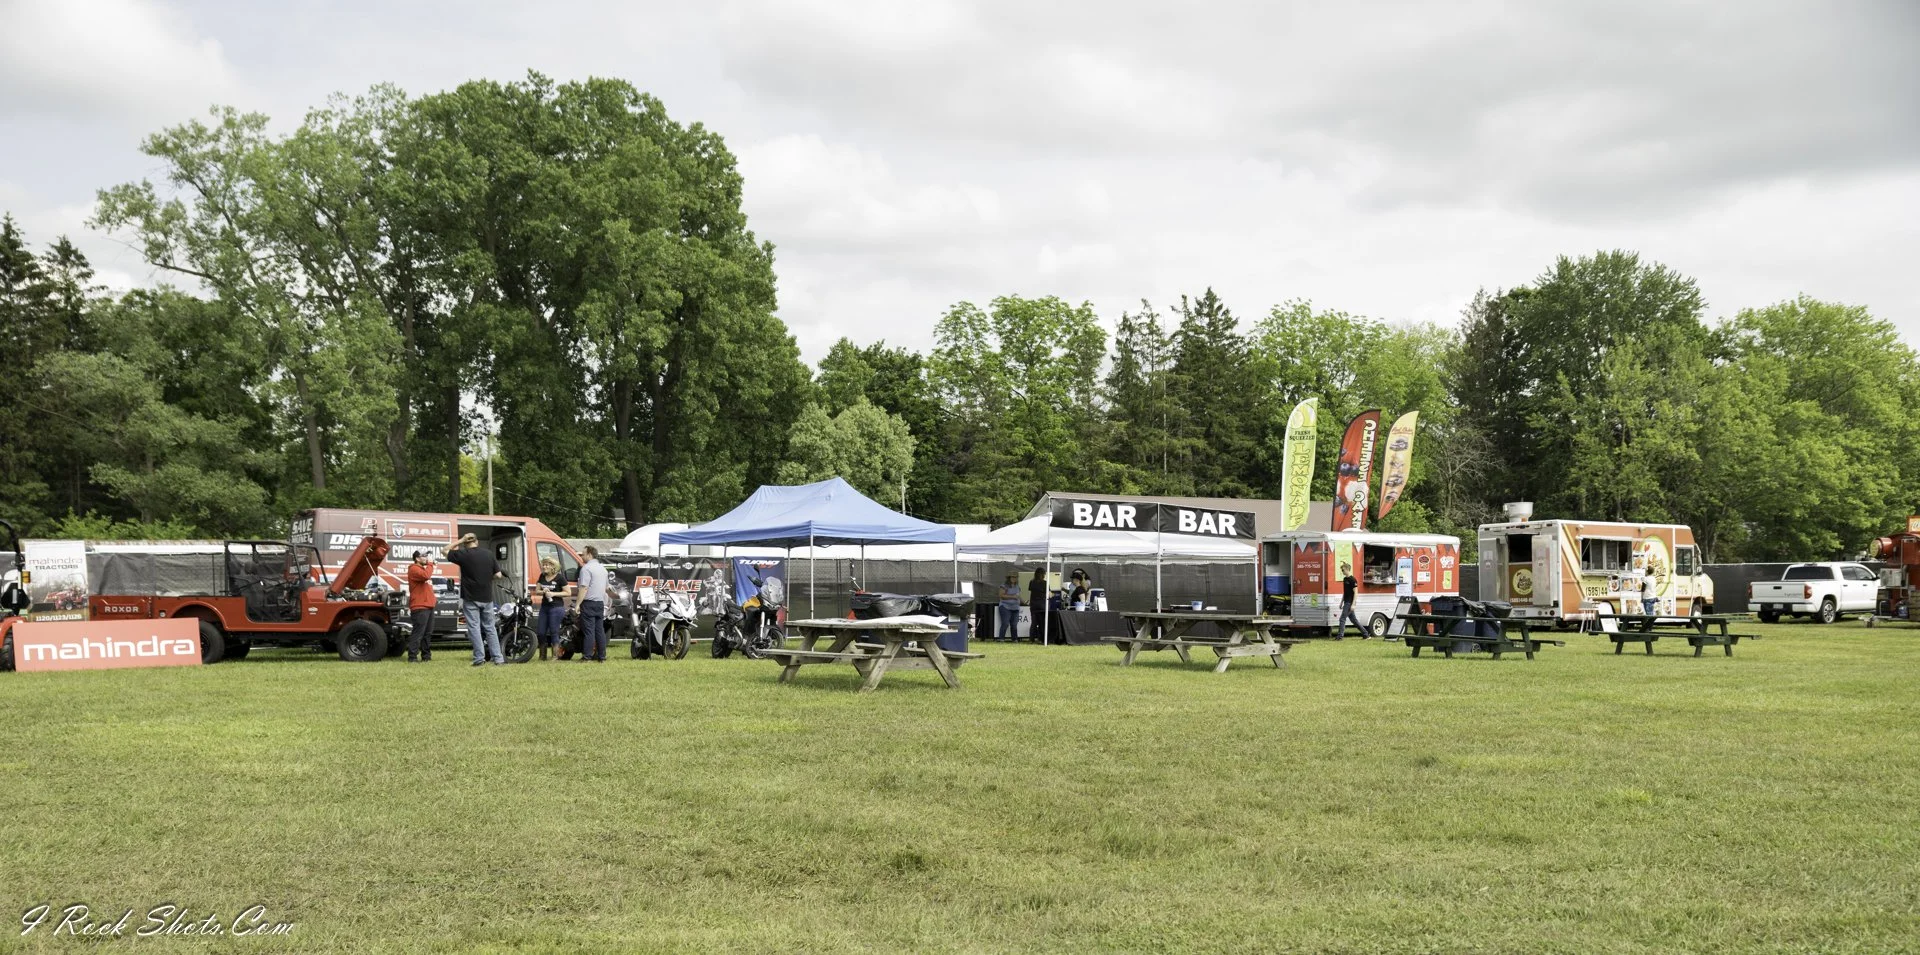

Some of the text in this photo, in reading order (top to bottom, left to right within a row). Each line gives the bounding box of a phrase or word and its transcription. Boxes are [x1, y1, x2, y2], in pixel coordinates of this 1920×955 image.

[1352, 419, 1377, 529] CHEESE CAKE
[1289, 443, 1311, 528] LEMONADE
[1073, 502, 1137, 528] BAR
[1178, 509, 1237, 536] BAR
[291, 518, 314, 534] SAVE
[408, 527, 445, 536] RAM
[329, 534, 363, 545] DIS
[28, 556, 83, 565] mahindra
[633, 576, 702, 592] PEAKE
[1586, 587, 1600, 596] (585)
[1018, 615, 1029, 623] RA
[23, 635, 195, 661] mahindra
